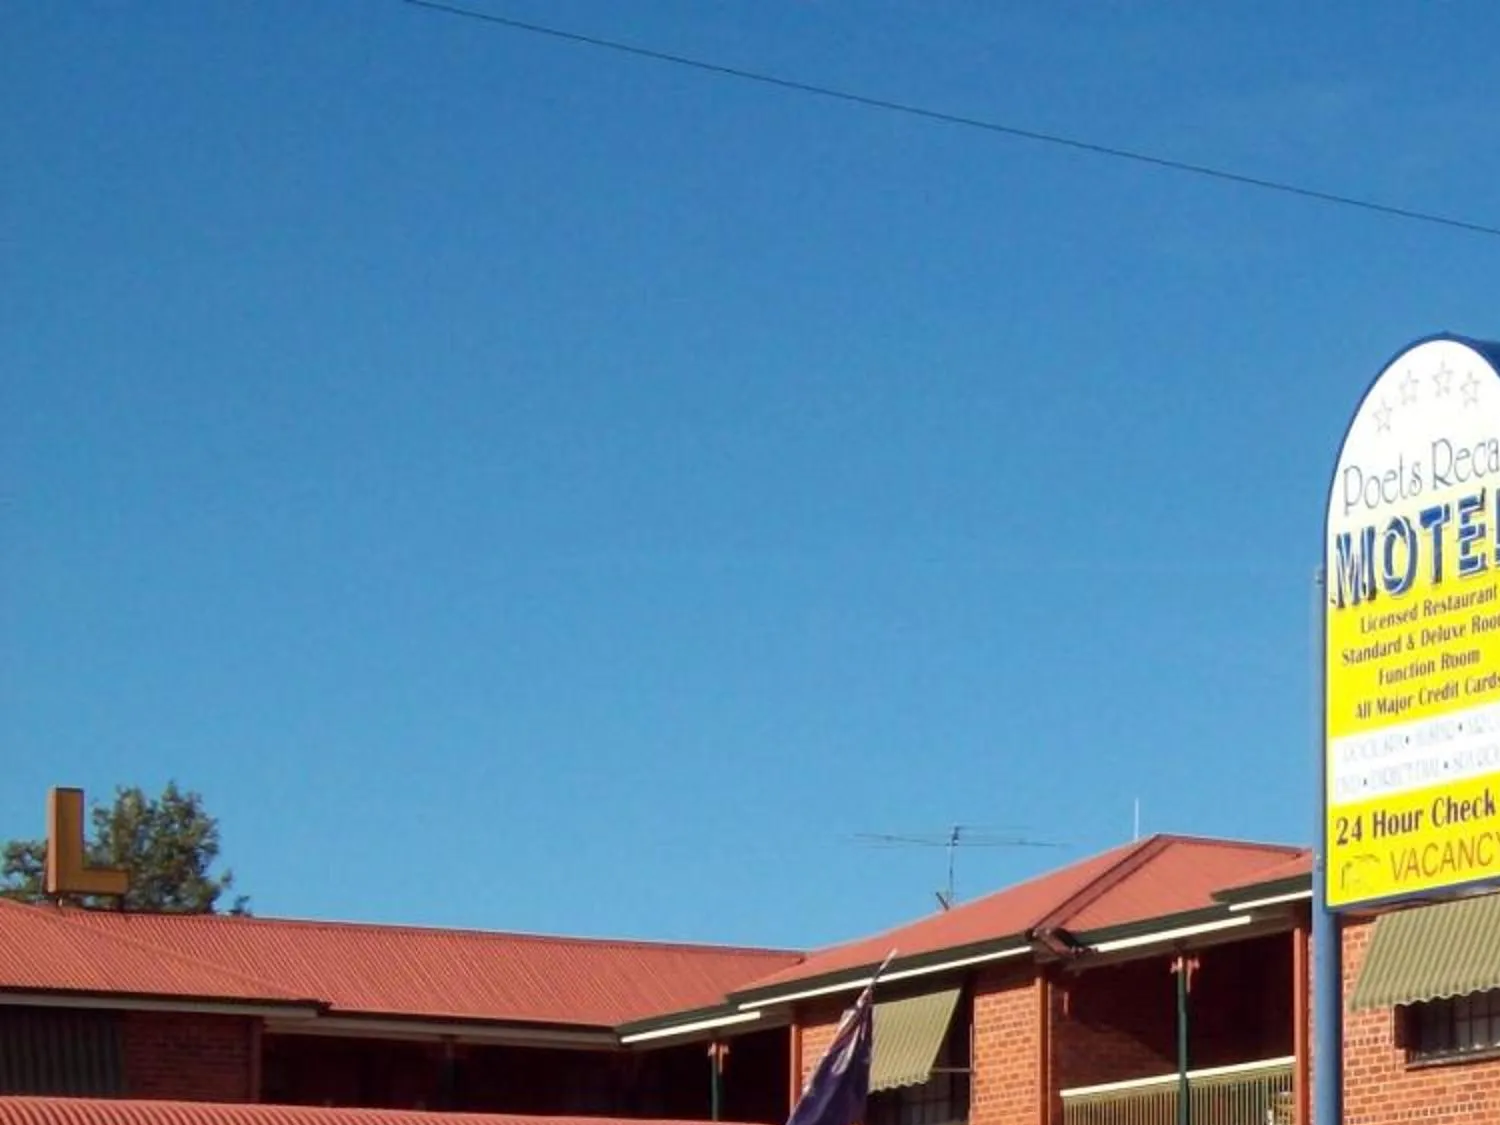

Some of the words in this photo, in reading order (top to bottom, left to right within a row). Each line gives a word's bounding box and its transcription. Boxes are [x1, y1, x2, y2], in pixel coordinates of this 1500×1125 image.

[1360, 603, 1419, 633] Licensed
[1423, 585, 1498, 618] Restaurant
[1342, 634, 1401, 665] Standard
[1406, 633, 1416, 650] &
[1421, 624, 1467, 648] Deluxe
[1378, 658, 1436, 686] Function
[1441, 647, 1481, 671] Room
[1355, 702, 1372, 720] All
[1376, 694, 1415, 716] Major
[1419, 682, 1459, 706] Credit
[1336, 816, 1363, 846] 24
[1372, 808, 1424, 839] Hour
[1432, 788, 1496, 828] Check
